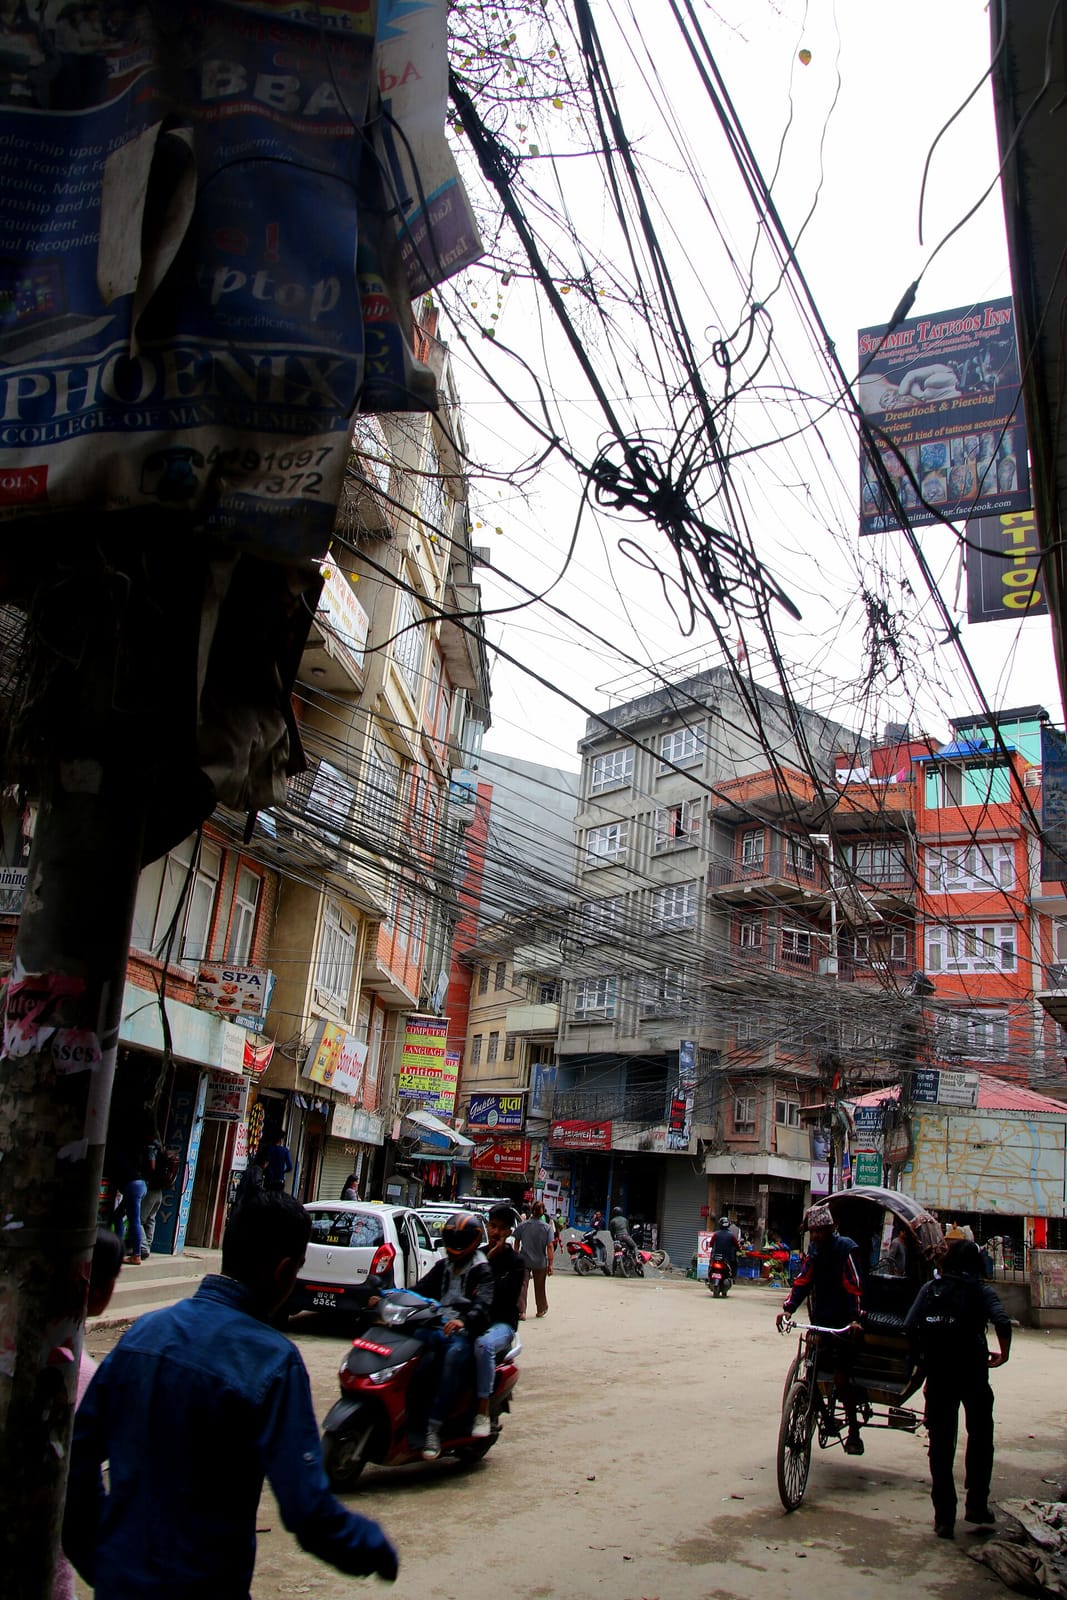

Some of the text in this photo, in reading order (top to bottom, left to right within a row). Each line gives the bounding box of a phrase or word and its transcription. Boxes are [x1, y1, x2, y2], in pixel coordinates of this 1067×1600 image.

[201, 60, 352, 117] BBA
[26, 160, 88, 177] Transfer
[858, 329, 915, 356] SUMMIT
[917, 314, 982, 345] TATTOOS
[983, 307, 1012, 329] INN
[1, 344, 347, 422] PHOENIX
[884, 394, 996, 423] Dreadlock & Piercing
[1, 411, 113, 446] COLLEGE
[124, 408, 162, 427] OF
[915, 427, 933, 439] kind
[934, 426, 945, 437] of
[945, 422, 973, 435] tattoos
[0, 473, 39, 490] OLN
[222, 970, 262, 985] SPA
[405, 1026, 446, 1038] COMPUTER
[403, 1045, 445, 1057] LANGUAGE
[212, 1071, 245, 1085] VENUS
[400, 1075, 414, 1085] +2
[402, 1066, 442, 1078] Tuition
[229, 1084, 247, 1093] CLINIC
[470, 1096, 496, 1120] Gupta
[499, 1096, 522, 1115] गुप्ता
